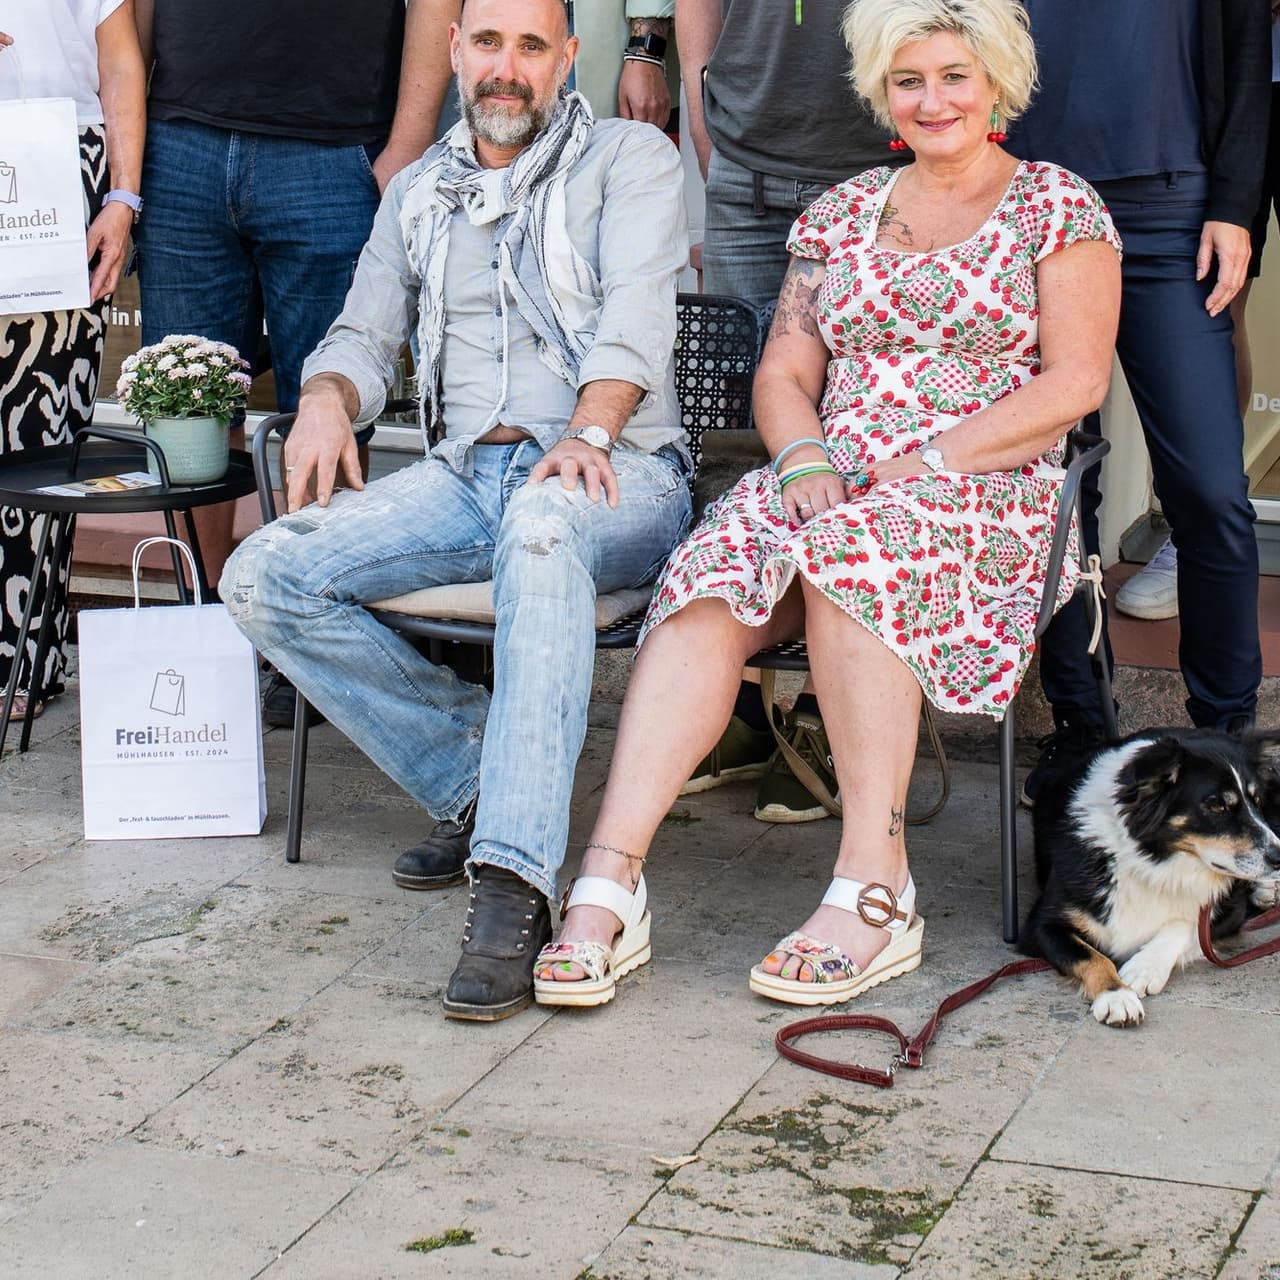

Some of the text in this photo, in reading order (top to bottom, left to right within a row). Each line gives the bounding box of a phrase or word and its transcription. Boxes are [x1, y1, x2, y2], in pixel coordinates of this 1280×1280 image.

[20, 233, 36, 241] EST.
[39, 231, 60, 239] 2024
[112, 306, 130, 326] in
[117, 751, 175, 759] MÜHLHAUSEN
